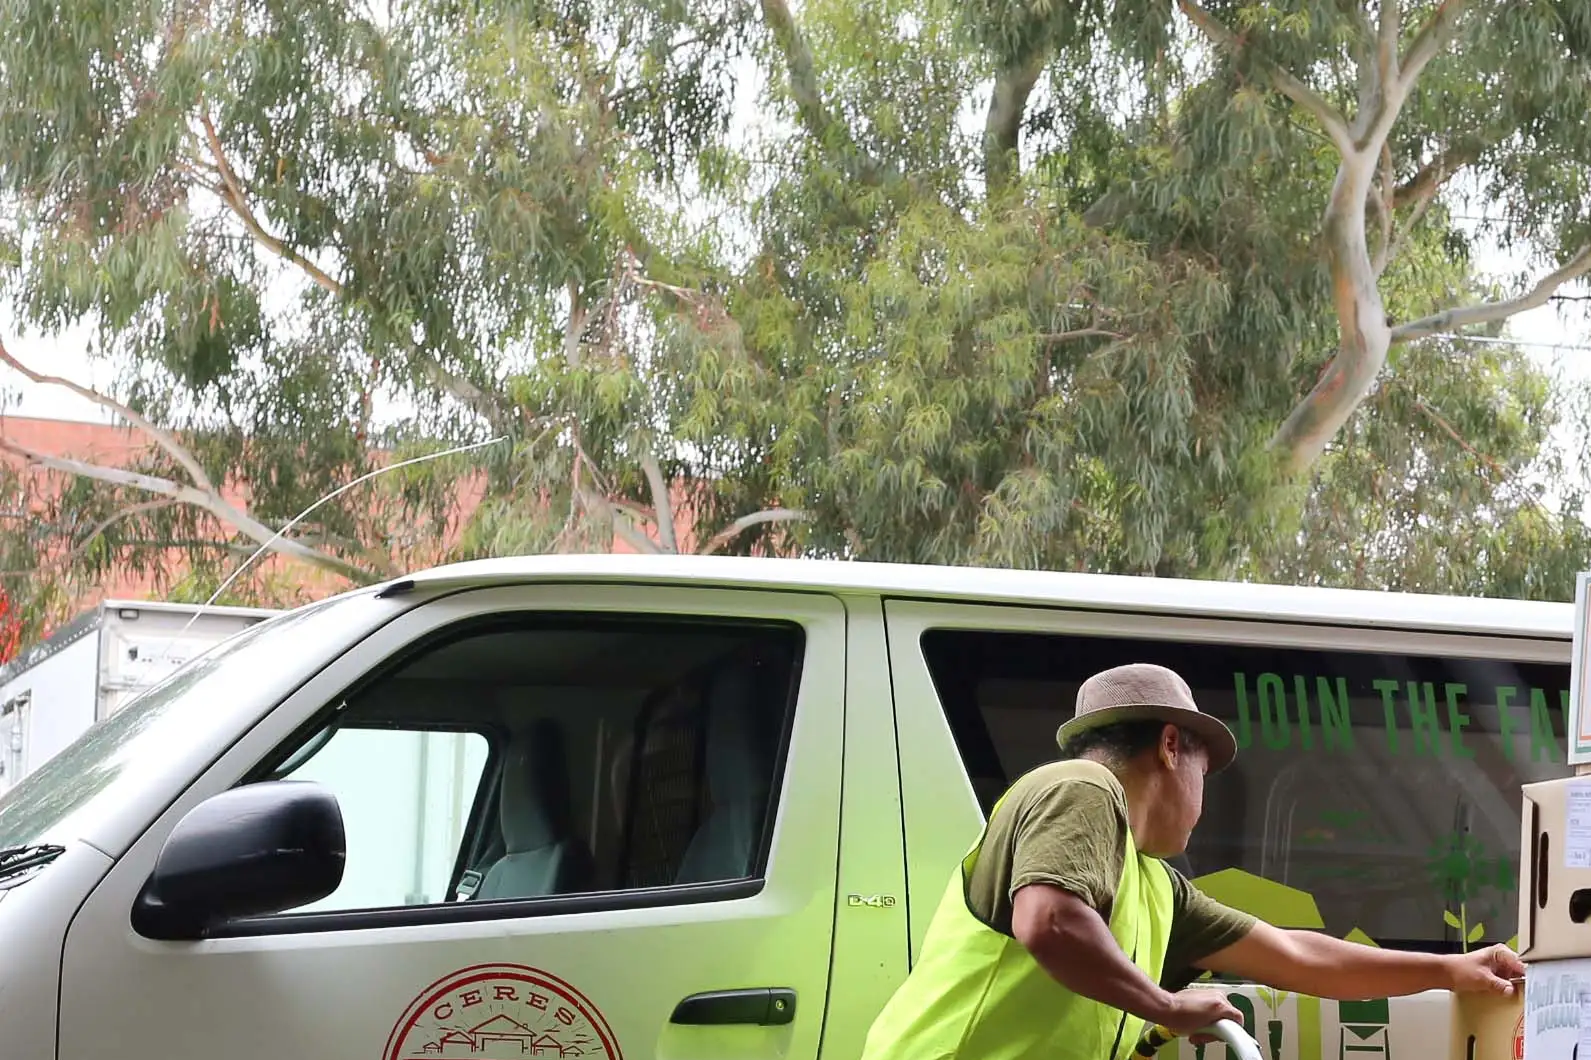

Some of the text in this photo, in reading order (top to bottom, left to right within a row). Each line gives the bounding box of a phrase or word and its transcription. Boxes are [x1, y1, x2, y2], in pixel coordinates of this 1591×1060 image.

[1233, 671, 1356, 754] JOIN
[1372, 679, 1475, 760] THE
[433, 985, 576, 1026] CERES
